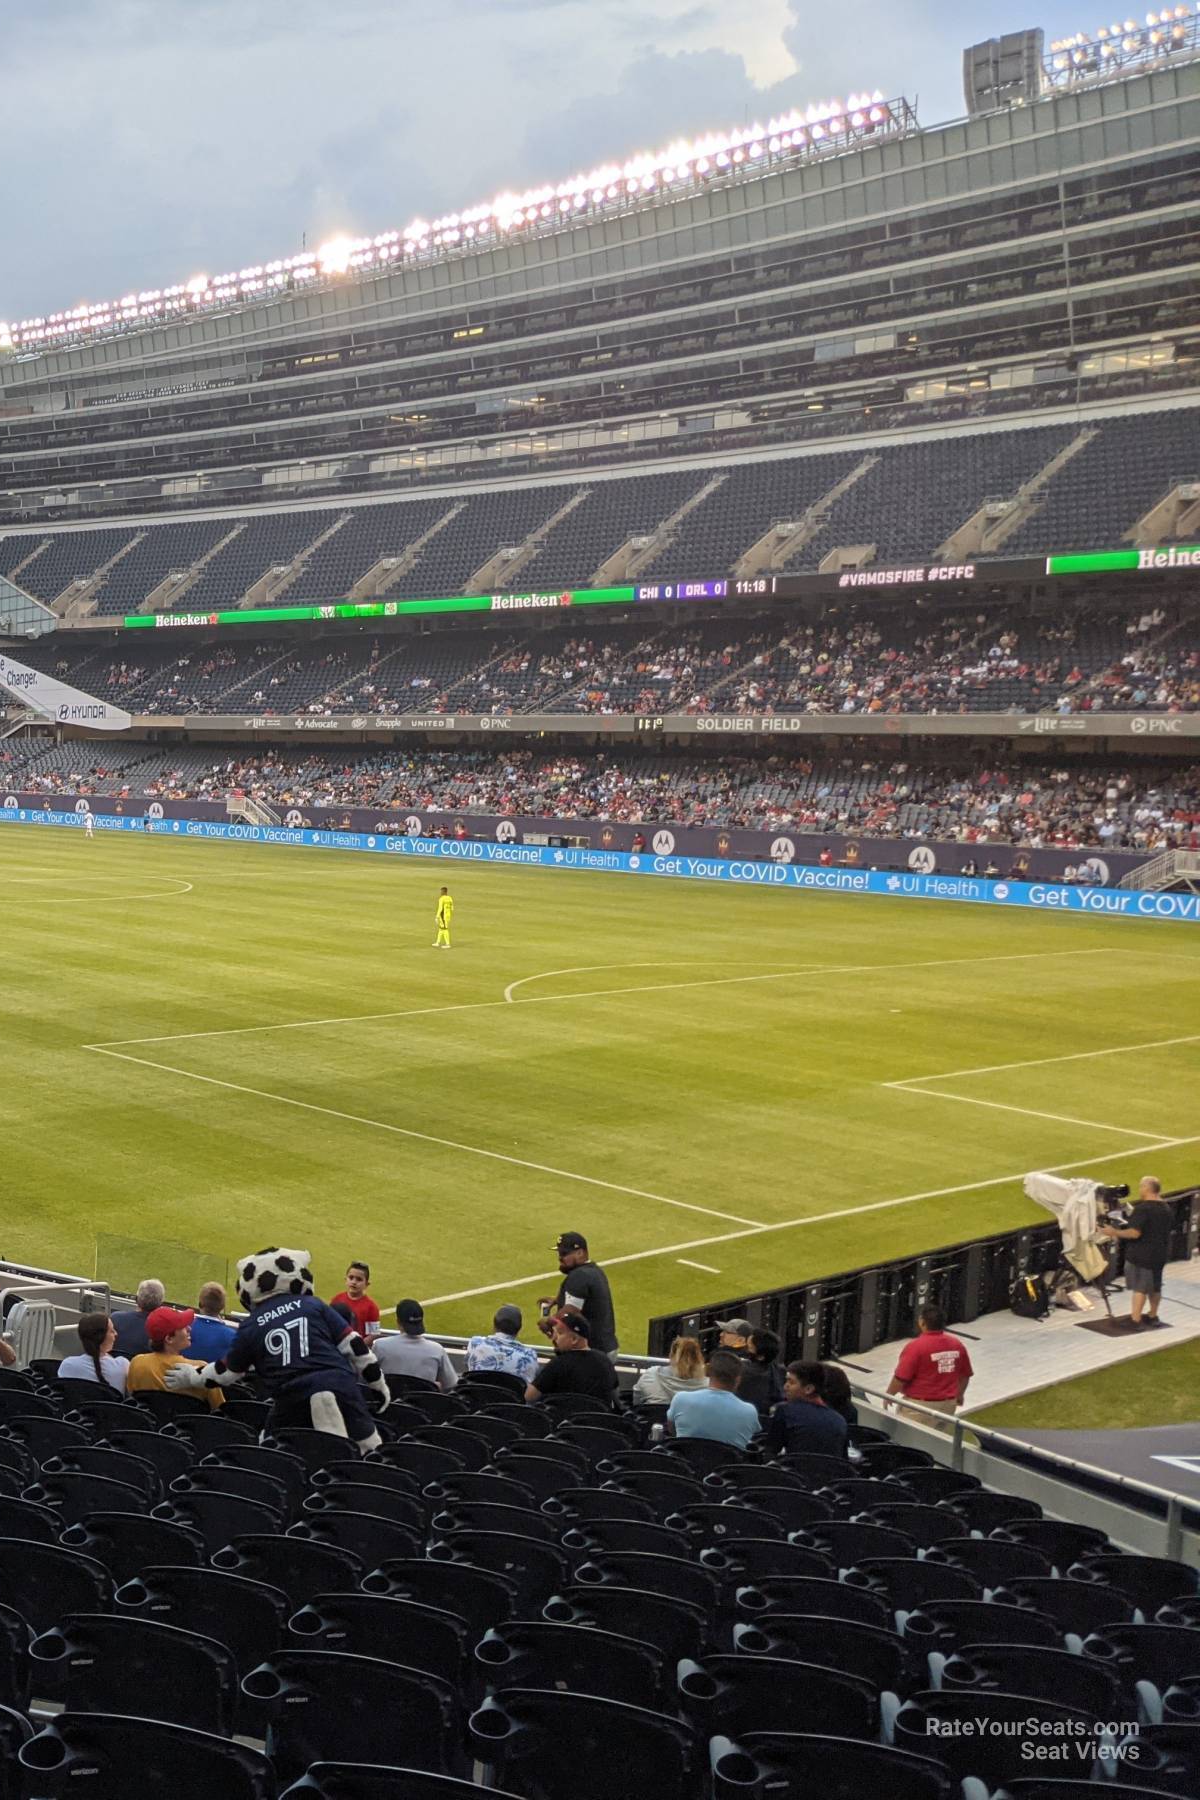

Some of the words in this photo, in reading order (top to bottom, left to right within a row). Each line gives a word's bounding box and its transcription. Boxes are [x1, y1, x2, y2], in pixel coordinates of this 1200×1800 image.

[838, 568, 924, 587] #VAMOSFIRE
[928, 565, 974, 582] #CFFC
[640, 586, 658, 599] CHI
[664, 586, 672, 598] 0
[686, 584, 707, 596] ORL
[714, 584, 722, 594] 0
[736, 580, 766, 594] 11:18
[492, 594, 558, 610] Heineken
[155, 614, 208, 628] Heineken
[6, 670, 38, 688] Changer.
[72, 705, 106, 719] HYUNDAI
[305, 719, 338, 728] Advocate
[491, 719, 511, 728] PNC
[697, 718, 754, 732] SOLDIER
[762, 718, 801, 732] FIELD
[1034, 717, 1058, 732] Lite
[1149, 719, 1182, 732] PNC
[32, 811, 45, 822] Get
[47, 812, 64, 824] Your
[93, 816, 124, 828] Vaccine!
[186, 822, 200, 834] Get
[202, 824, 226, 836] Your
[228, 825, 260, 838] COVID
[263, 828, 304, 842] Vaccine!
[320, 833, 330, 845] UI
[333, 834, 361, 847] Health
[386, 837, 406, 852] Get
[410, 838, 438, 854] Your
[441, 842, 483, 858] COVID
[487, 846, 542, 863] Vaccine!
[565, 853, 578, 864] UI
[581, 854, 619, 868] Health
[654, 857, 683, 874] Get
[686, 859, 725, 878] Your
[729, 864, 787, 883] COVID
[794, 867, 869, 890] Vaccine!
[902, 876, 917, 892] UI
[922, 878, 979, 897] Health
[1028, 886, 1069, 906] Get
[1076, 889, 1130, 910] Your
[256, 1300, 302, 1326] SPARKY
[264, 1316, 310, 1366] 97
[70, 1767, 98, 1776] verizon
